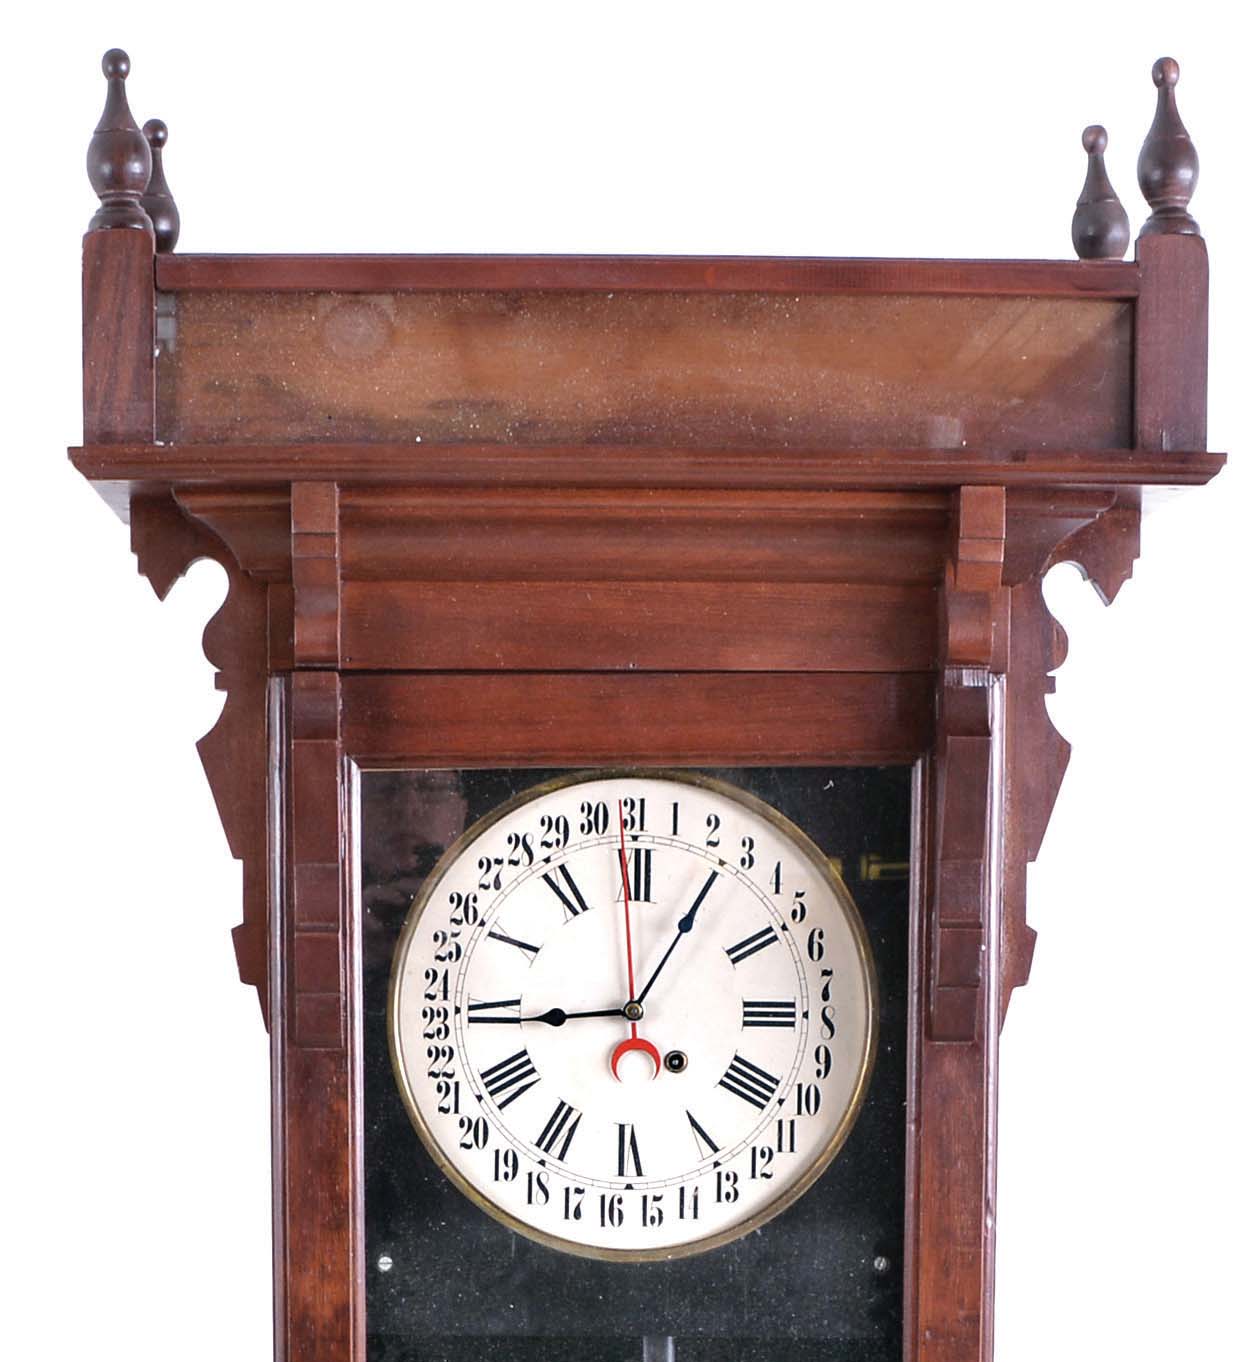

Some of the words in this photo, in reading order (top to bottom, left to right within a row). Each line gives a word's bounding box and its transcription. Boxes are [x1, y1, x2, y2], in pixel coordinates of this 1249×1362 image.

[540, 815, 569, 848] 29
[580, 802, 609, 835] 30
[622, 799, 646, 832] 31
[671, 802, 679, 836] 1
[705, 814, 721, 848] 2
[507, 833, 534, 866] 28
[741, 836, 755, 870] 3
[478, 858, 504, 891] 27
[770, 861, 783, 895] 4
[449, 892, 478, 925] 26
[791, 891, 806, 921] 5
[433, 931, 462, 962] 25
[807, 927, 824, 961] 6
[425, 968, 449, 1000] 24
[821, 968, 833, 1002] 7
[423, 1006, 450, 1040] 23
[742, 1000, 796, 1031] III
[821, 1005, 835, 1040] 8
[427, 1045, 455, 1079] 22
[814, 1045, 831, 1080] 9
[437, 1081, 460, 1114] 21
[794, 1083, 820, 1116] 10
[458, 1117, 488, 1149] 20
[776, 1119, 795, 1152] 11
[494, 1149, 519, 1182] 19
[749, 1146, 774, 1179] 12
[526, 1172, 550, 1205] 18
[563, 1186, 585, 1219] 17
[678, 1186, 700, 1220] 14
[715, 1171, 739, 1203] 13
[600, 1194, 624, 1227] 16
[641, 1194, 664, 1227] 15
